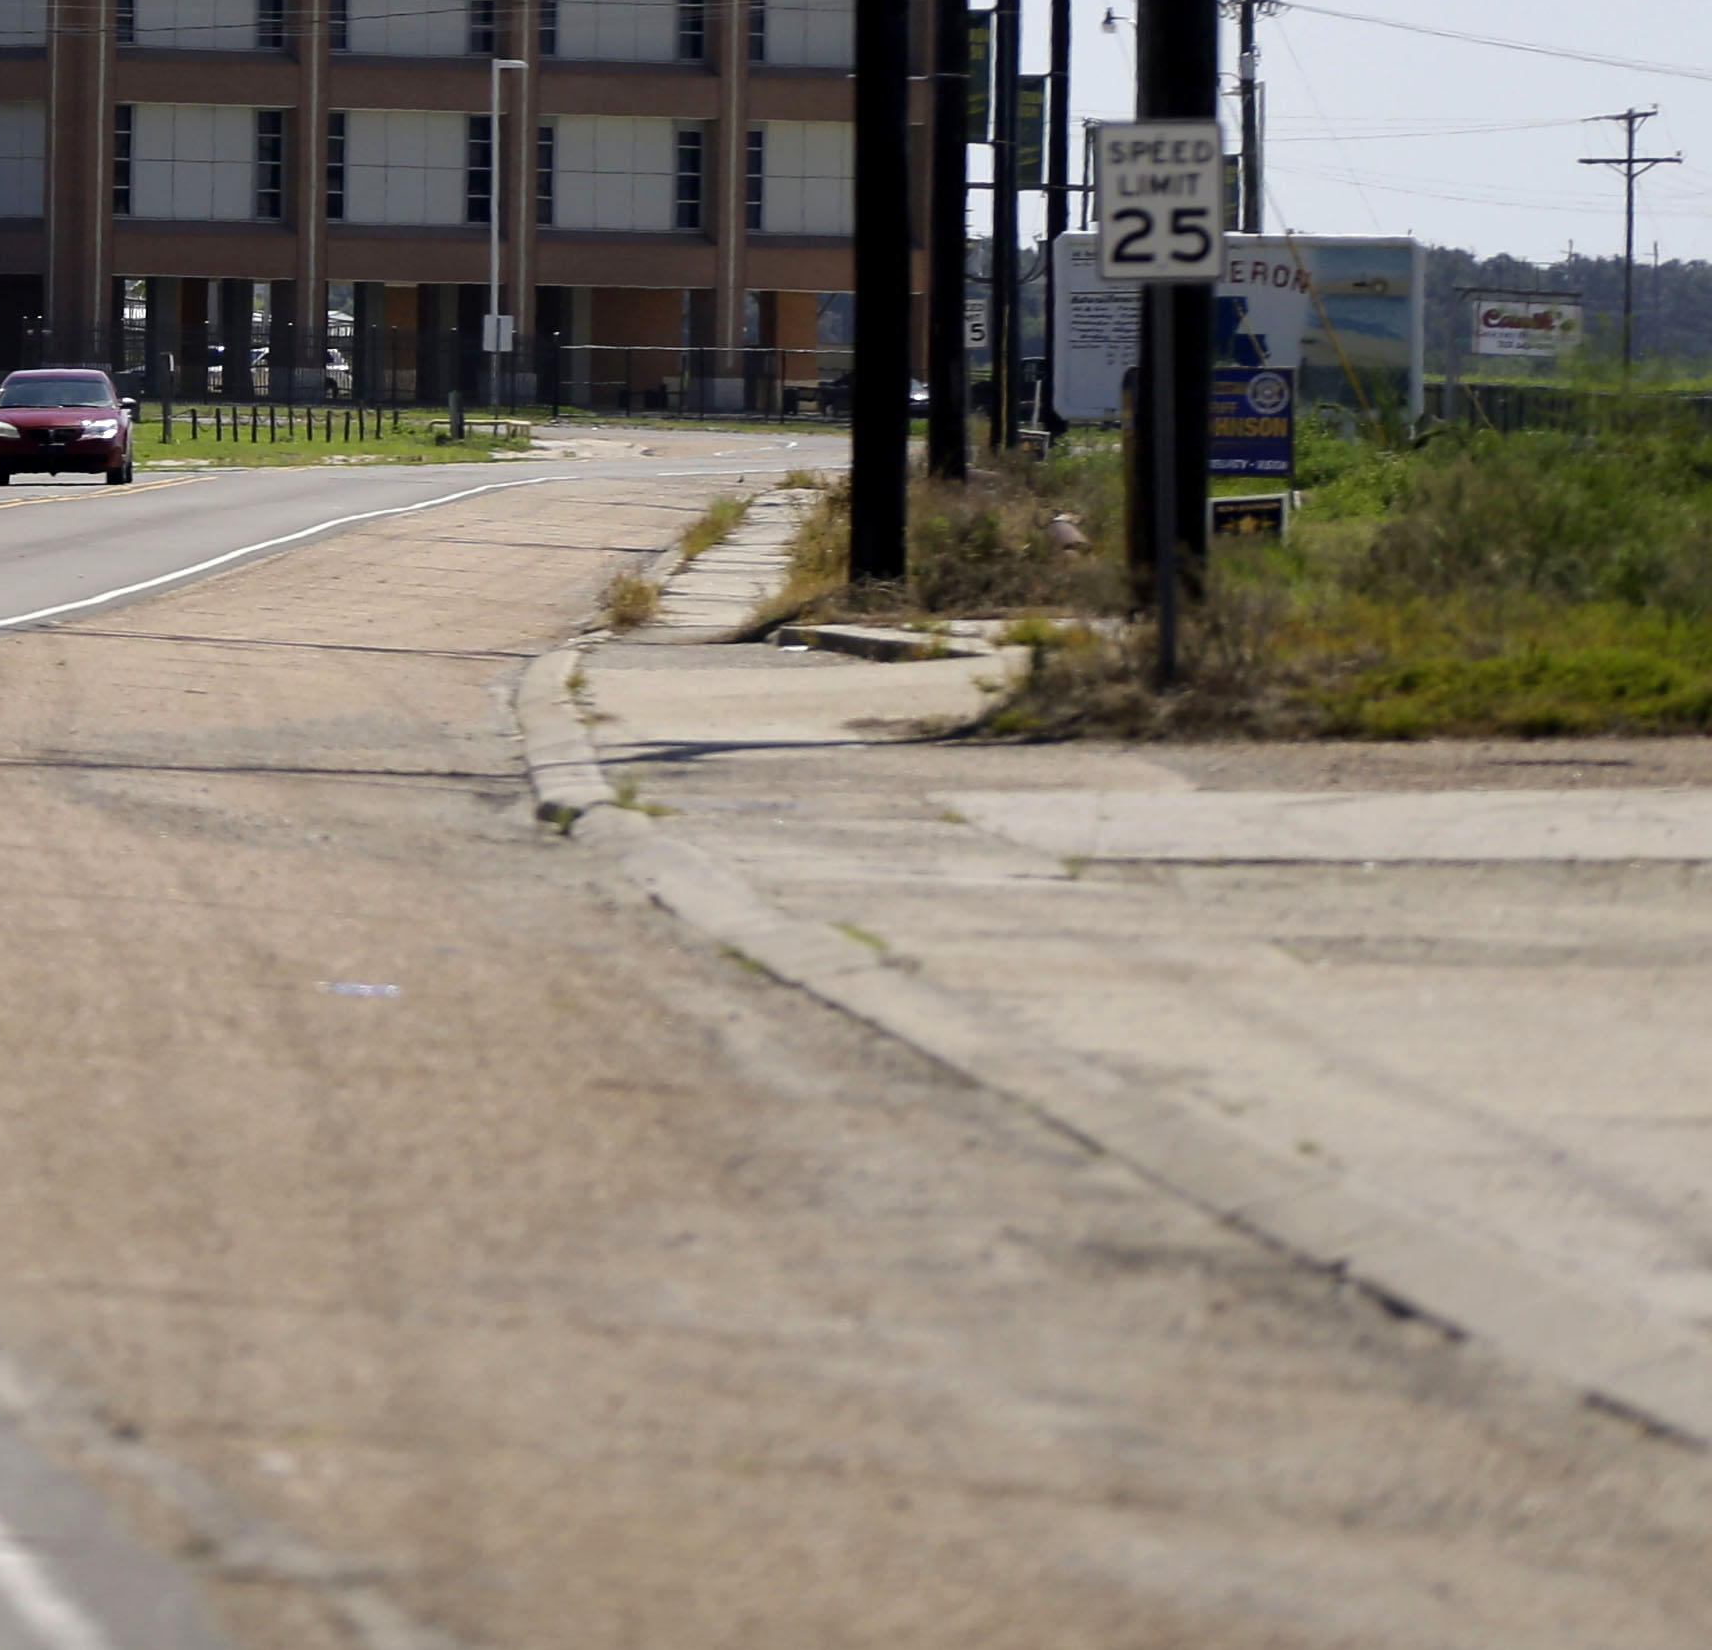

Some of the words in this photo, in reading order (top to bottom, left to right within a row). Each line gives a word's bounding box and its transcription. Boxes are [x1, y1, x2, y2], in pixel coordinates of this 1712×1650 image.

[1108, 139, 1214, 165] SPEED
[1118, 172, 1200, 197] LIMIT
[1112, 207, 1212, 263] 25
[1230, 260, 1310, 294] ERON
